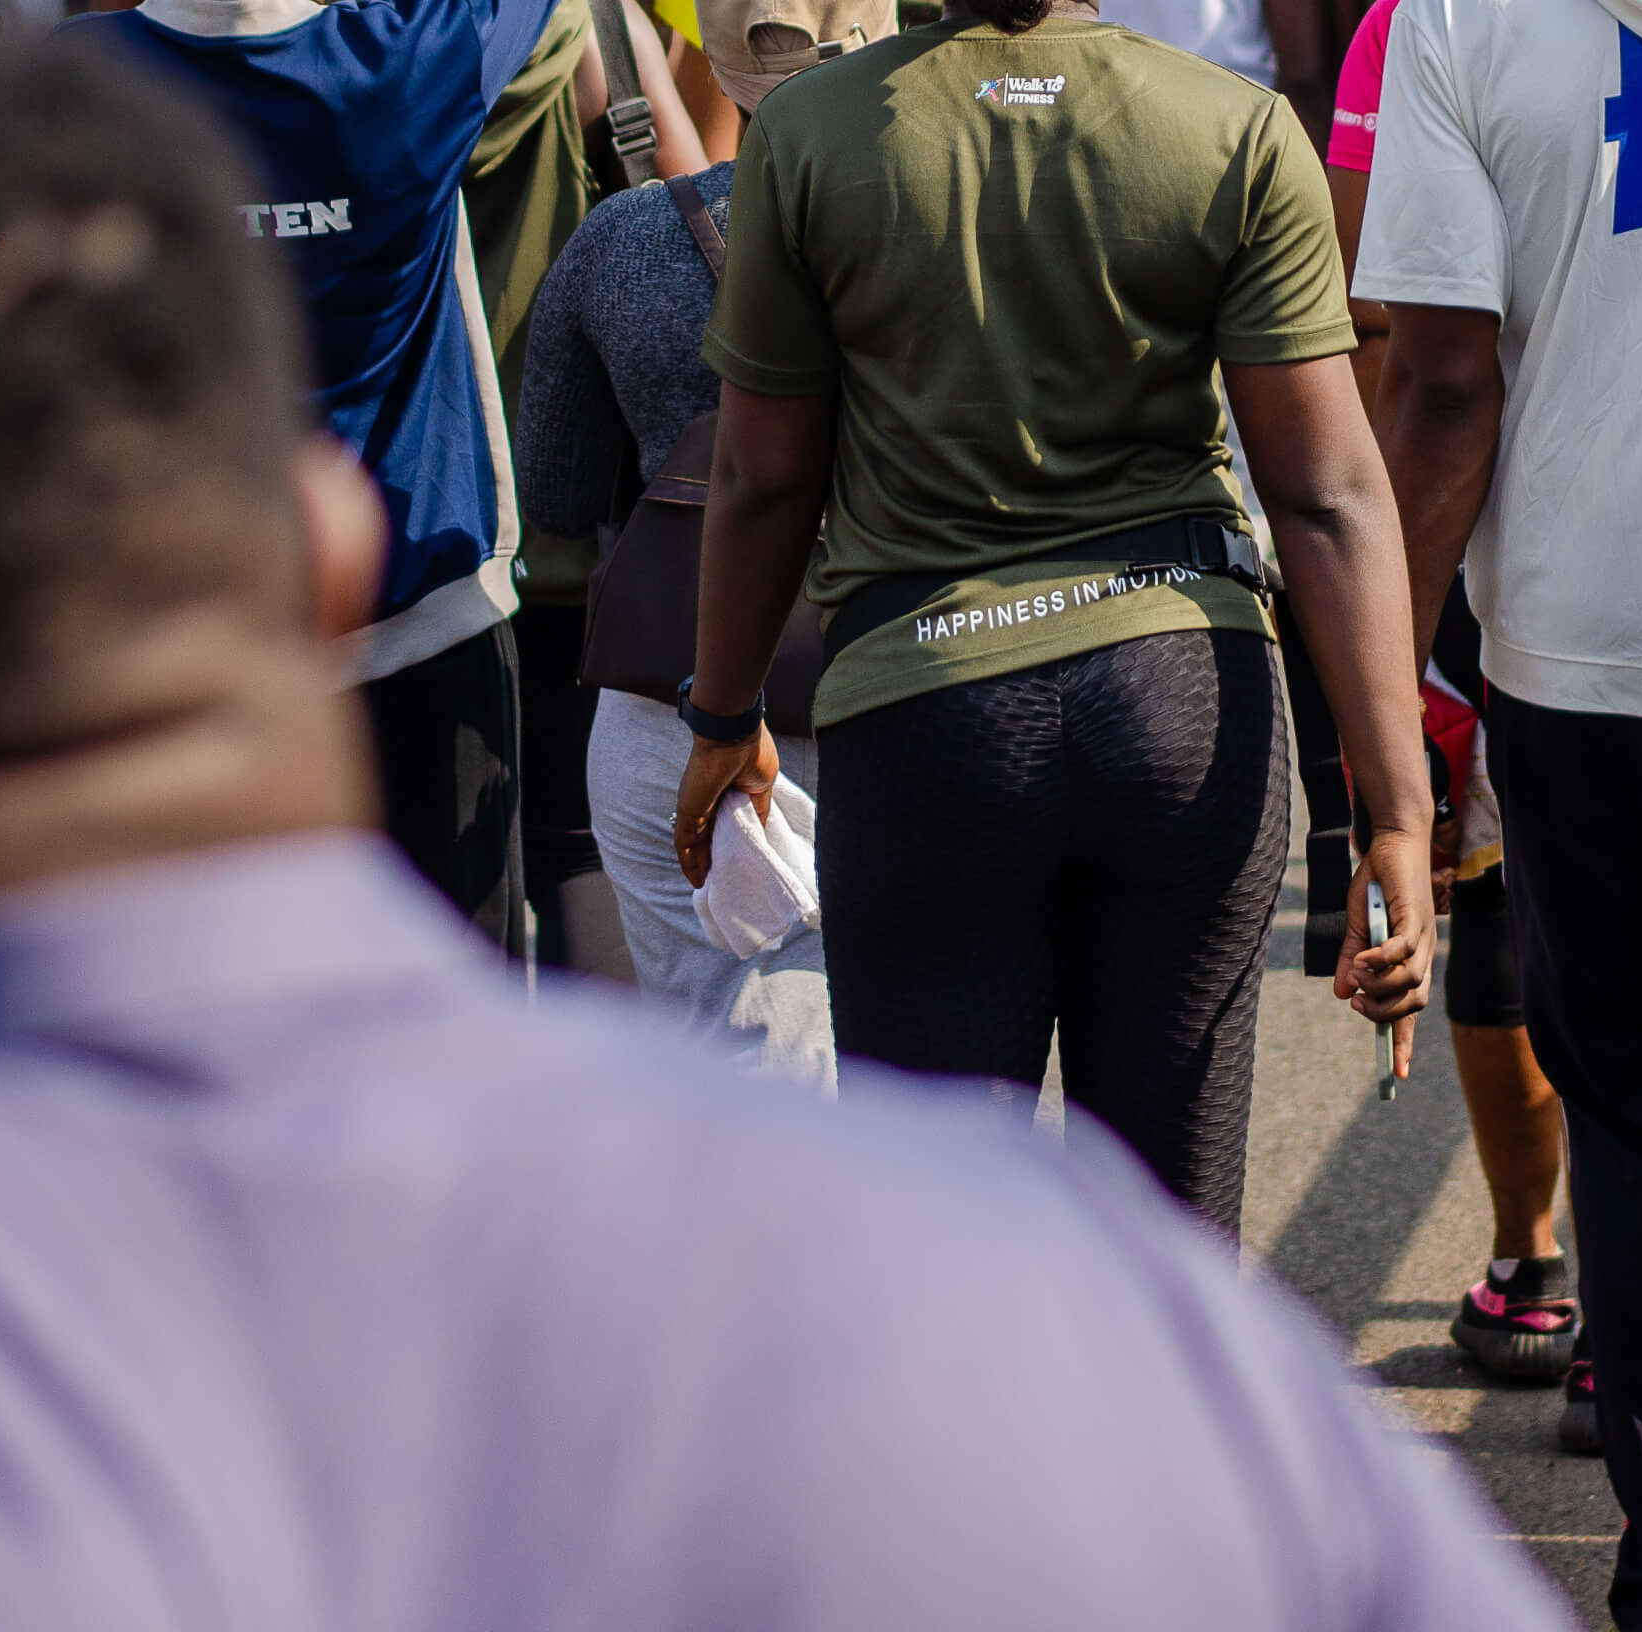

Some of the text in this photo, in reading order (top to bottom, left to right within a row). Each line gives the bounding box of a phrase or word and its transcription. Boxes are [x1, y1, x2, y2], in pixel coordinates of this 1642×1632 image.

[1007, 93, 1056, 105] FITNESS
[916, 589, 1066, 643] HAPPINESS
[1072, 580, 1100, 606] IN
